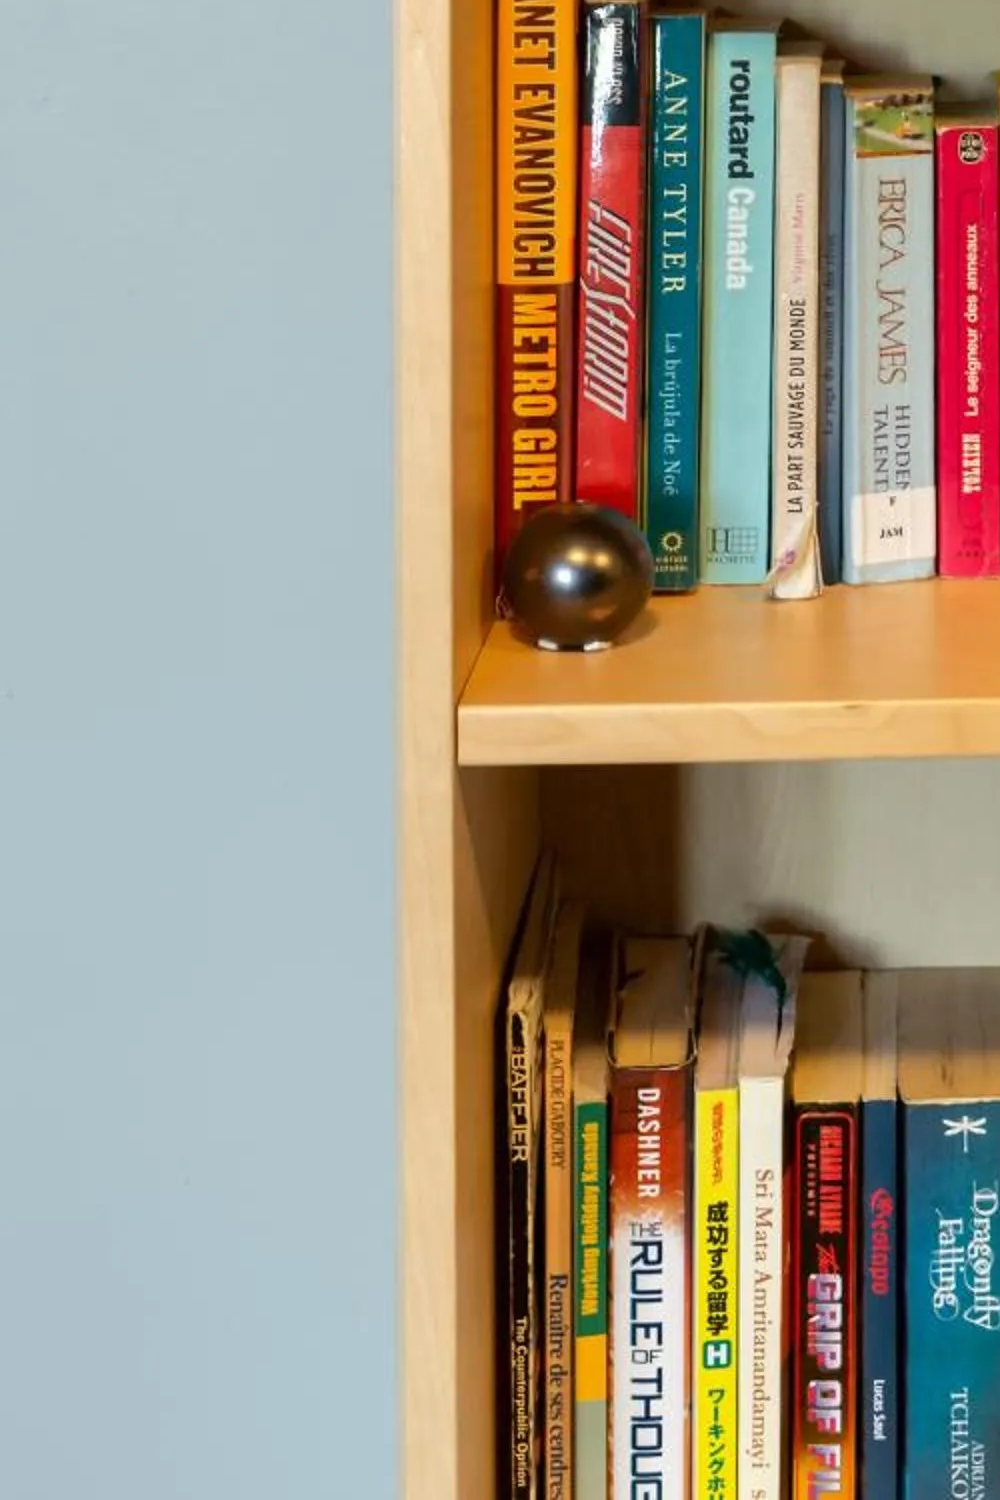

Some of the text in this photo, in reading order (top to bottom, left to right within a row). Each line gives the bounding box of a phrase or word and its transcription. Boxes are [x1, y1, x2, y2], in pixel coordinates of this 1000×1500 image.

[511, 82, 557, 280] EVANOVICH
[661, 69, 689, 295] ANNE TYLER
[725, 59, 756, 291] routard Canada
[874, 178, 906, 387] ERICA JAMES
[962, 223, 982, 494] TOLKIEN Le seigneur des anneaux
[511, 293, 558, 511] METRO GIRL
[659, 331, 684, 497] La brújula de Noé
[788, 298, 806, 514] LA PART SAUVAGE DU MONDE
[549, 1100, 567, 1170] GABOURY
[636, 1087, 662, 1199] DASHNER
[630, 1238, 663, 1347] RULE
[746, 1168, 773, 1470] Sri Mata Amritanandamayi
[929, 1209, 965, 1321] Falling
[513, 1316, 529, 1489] The Counterpublic Option
[548, 1273, 569, 1500] Renaître de ses cendres
[871, 1379, 887, 1414] Lucas
[971, 1440, 986, 1500] ADRIAN
